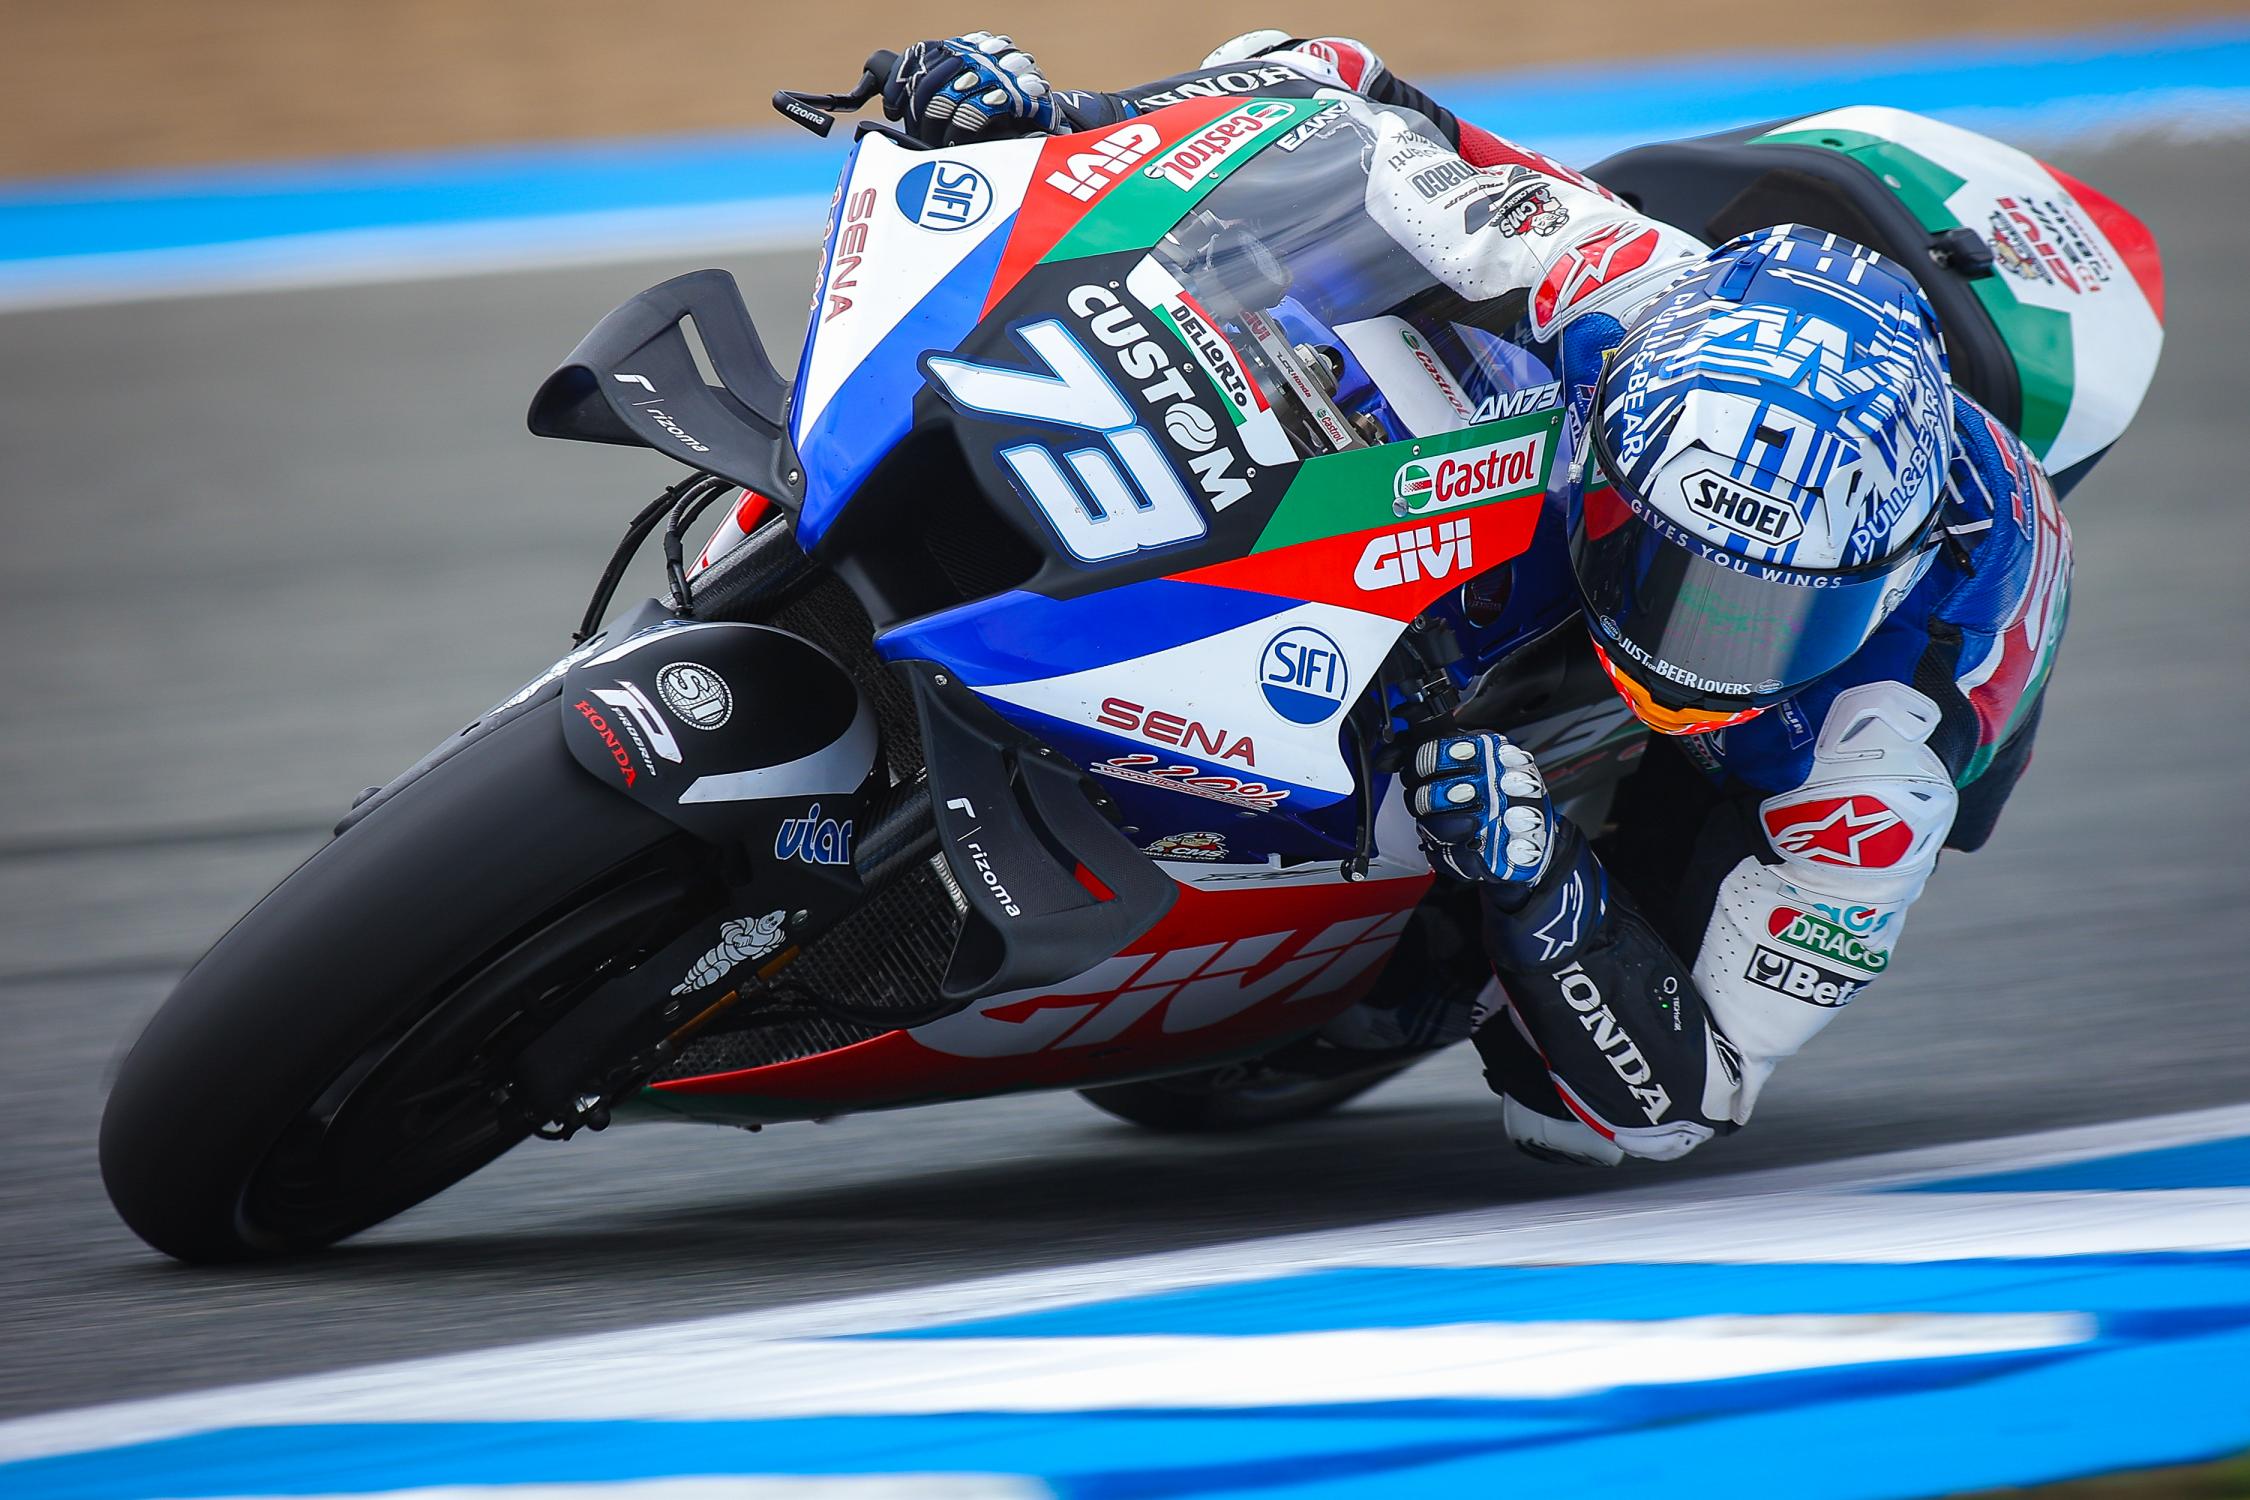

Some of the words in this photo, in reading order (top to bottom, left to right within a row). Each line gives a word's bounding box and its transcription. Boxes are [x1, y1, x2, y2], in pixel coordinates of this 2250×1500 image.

[785, 100, 826, 127] rizoma
[1162, 112, 1263, 181] Castrol
[930, 162, 979, 225] SIFI
[1045, 124, 1162, 201] GIVI
[1500, 200, 1537, 239] CMS
[825, 188, 877, 323] SENA
[1170, 305, 1248, 408] DELLORTO
[1415, 349, 1470, 415] Castrol
[1620, 292, 1694, 460] PULL&BEAR
[647, 407, 710, 453] rizoma
[1321, 416, 1345, 443] Castrol
[1469, 380, 1562, 425] AM73
[926, 316, 1207, 564] 73
[1437, 440, 1536, 502] Castrol
[1854, 389, 1939, 554] PULL&BEAR
[1698, 477, 1789, 538] SHOEI
[1353, 517, 1473, 592] GIVI
[1630, 499, 1689, 548] GIVES
[1701, 544, 1748, 574] YOU
[1762, 567, 1843, 590] WINGS
[1267, 640, 1338, 694] SIFI
[1618, 637, 1653, 666] JUST
[1655, 659, 1698, 688] BEER
[1697, 676, 1753, 696] LOVERS
[574, 700, 638, 789] HONDA
[610, 706, 657, 777] PROGRIP
[1096, 696, 1256, 768] SENA
[774, 802, 853, 866] viar
[966, 842, 1021, 918] rizoma
